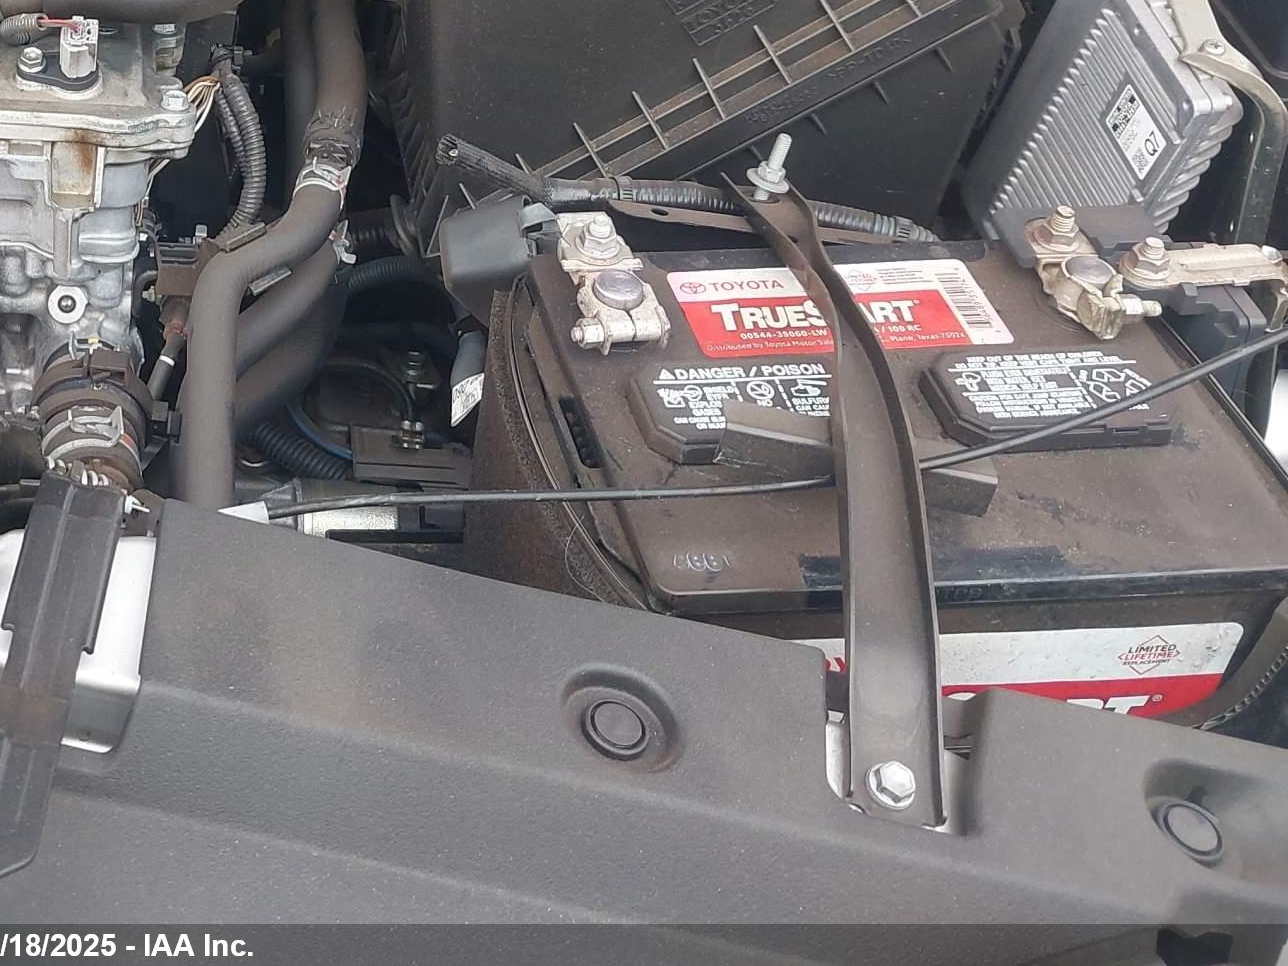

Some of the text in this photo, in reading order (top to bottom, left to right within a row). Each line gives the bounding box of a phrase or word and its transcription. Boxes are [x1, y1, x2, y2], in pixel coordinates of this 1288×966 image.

[1144, 130, 1160, 156] Q7
[711, 279, 785, 292] TOYOTA
[674, 367, 746, 380] DANGER
[761, 363, 826, 376] POISON
[1124, 651, 1175, 660] LIFETIME
[1127, 644, 1177, 654] LIMITED
